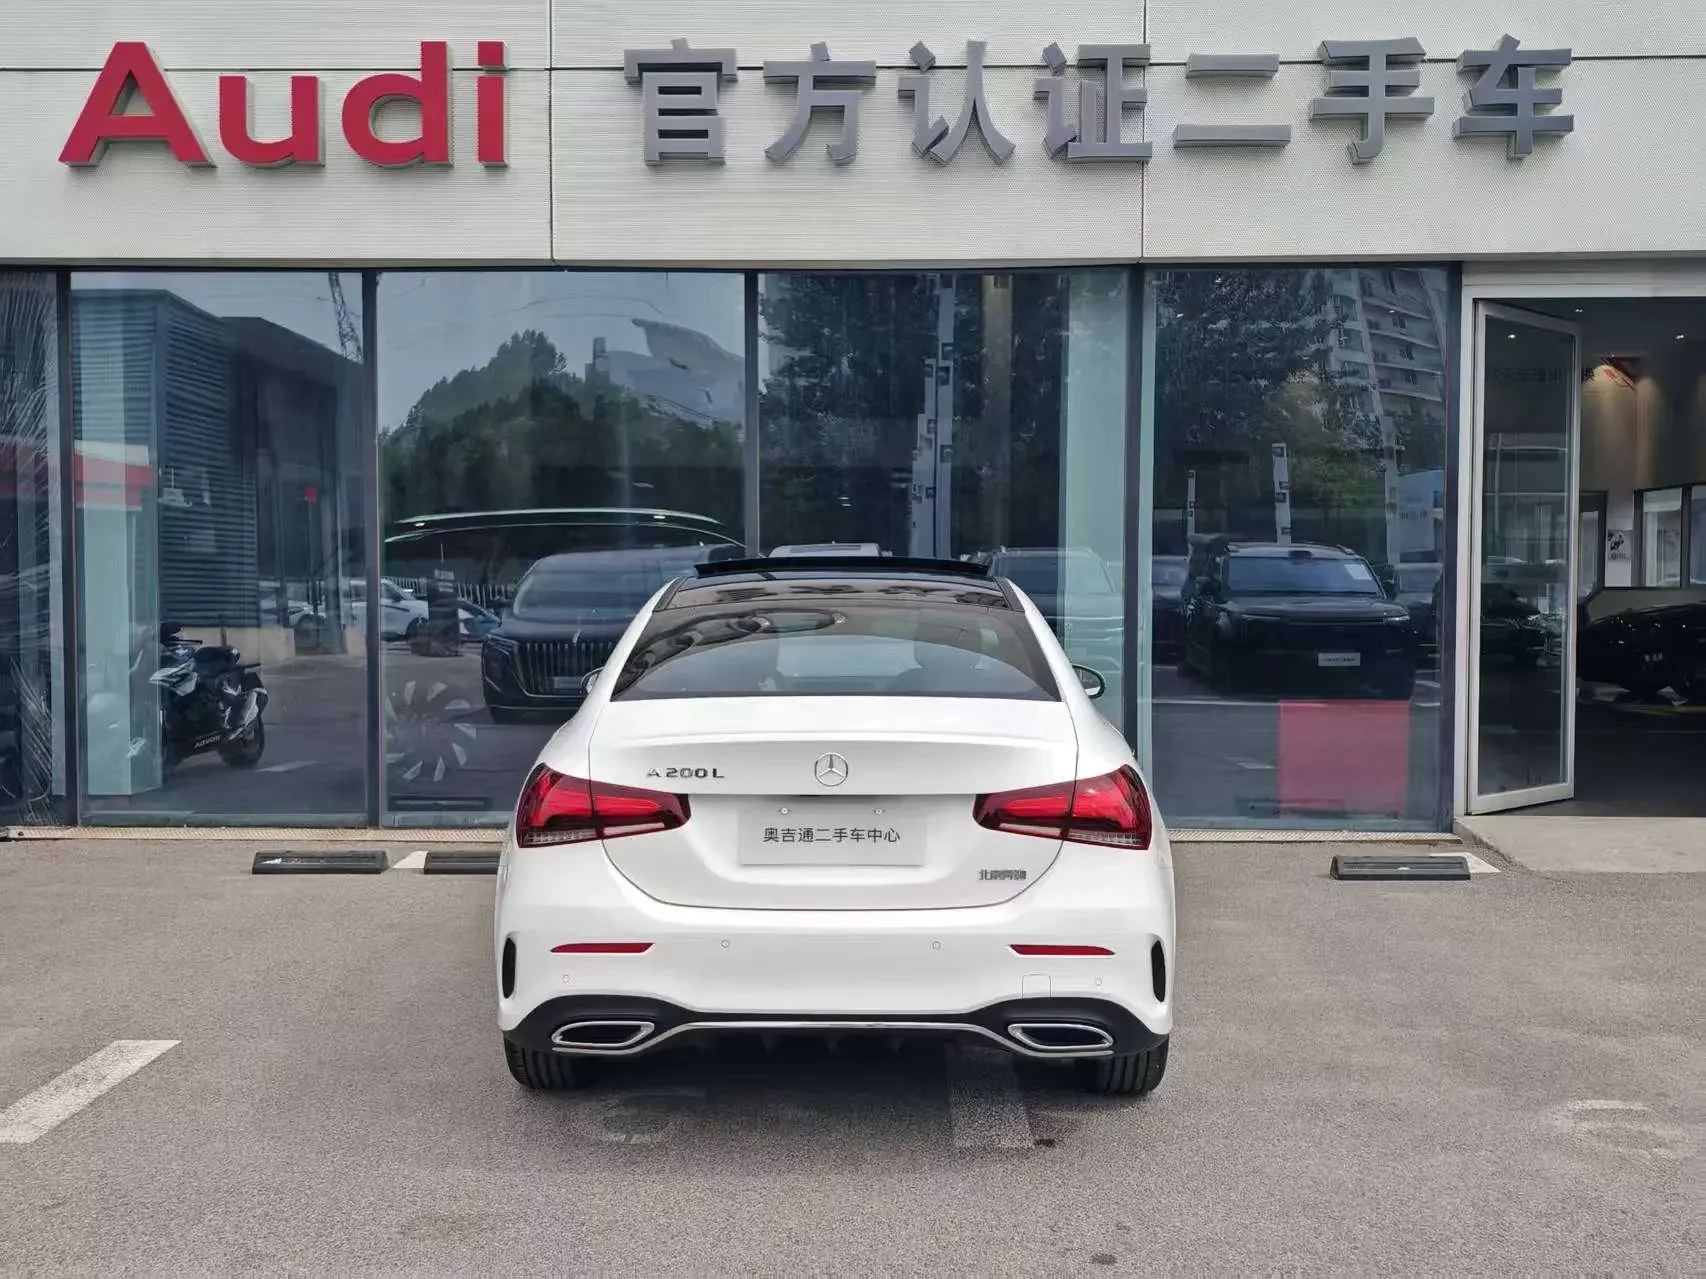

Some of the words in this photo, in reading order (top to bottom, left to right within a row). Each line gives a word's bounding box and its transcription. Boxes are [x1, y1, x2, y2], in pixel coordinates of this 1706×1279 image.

[58, 41, 510, 168] Audi
[623, 34, 1575, 166] 官方认证二手车
[762, 827, 901, 844] 奥吉通二手车中心
